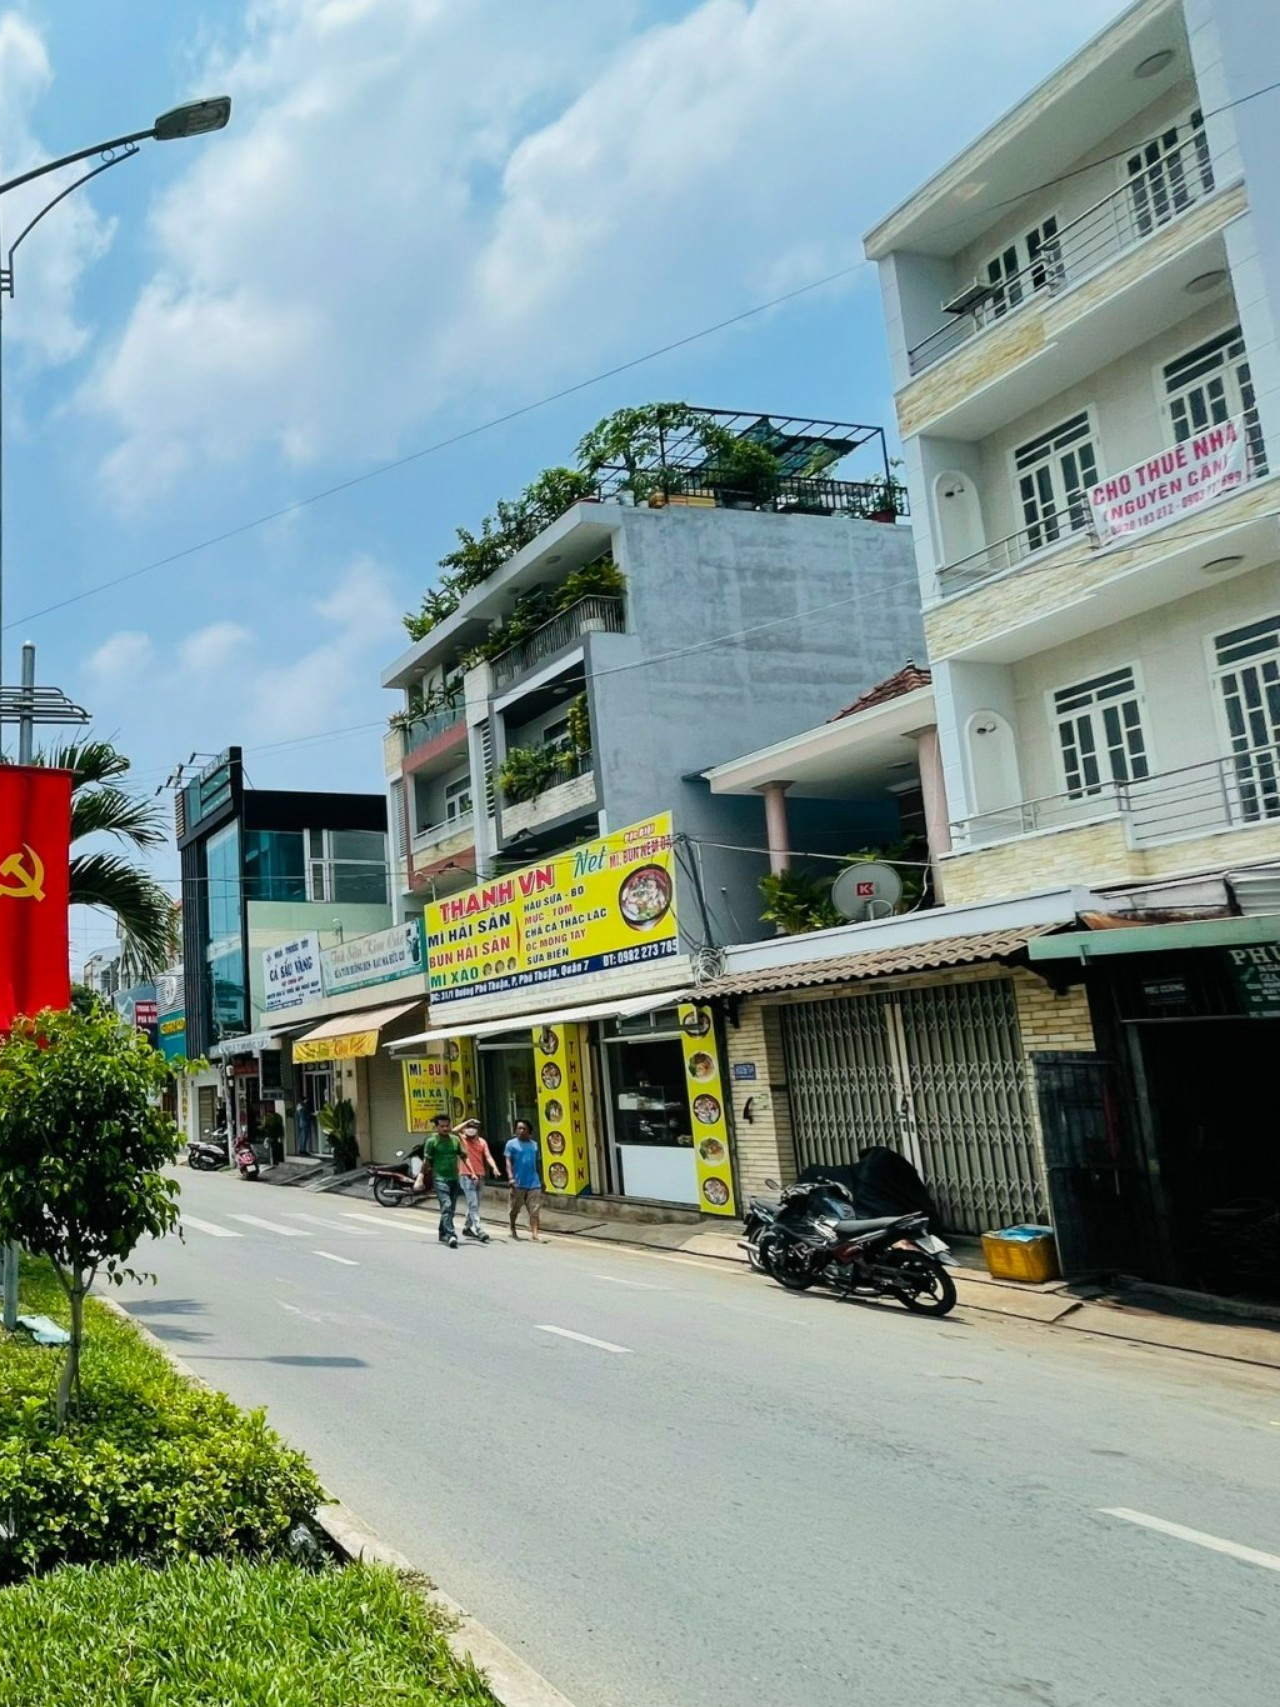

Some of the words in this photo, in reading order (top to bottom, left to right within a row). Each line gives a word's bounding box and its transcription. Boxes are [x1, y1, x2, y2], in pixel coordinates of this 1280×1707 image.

[1093, 474, 1132, 507] CHO
[1135, 443, 1189, 487] THUÊ
[1193, 419, 1238, 461] NHÀ
[439, 880, 515, 925] THANH
[518, 864, 555, 898] VN
[574, 845, 606, 878] Net
[583, 960, 590, 972] 7
